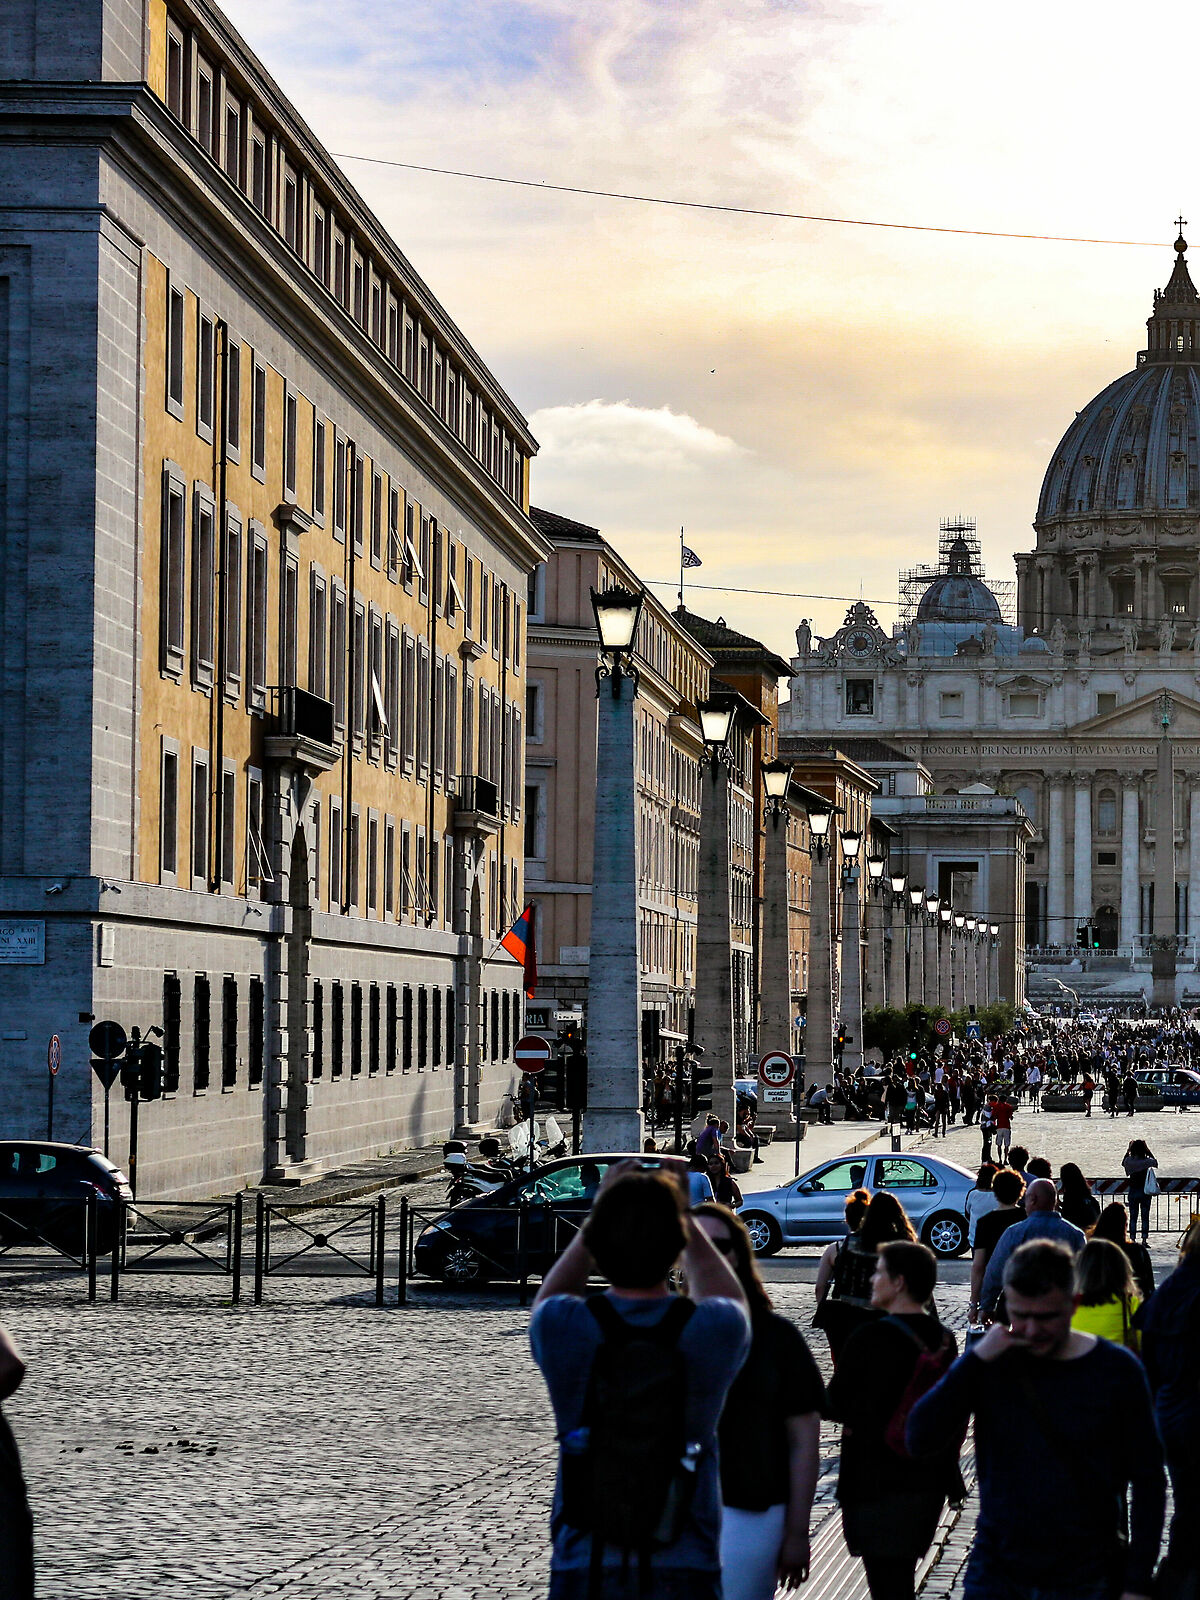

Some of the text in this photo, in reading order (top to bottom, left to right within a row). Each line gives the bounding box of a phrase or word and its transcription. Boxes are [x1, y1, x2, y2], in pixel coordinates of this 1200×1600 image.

[904, 745, 916, 754] IN
[922, 745, 979, 755] HONOREM
[982, 745, 1038, 755] PRINCIPIS
[1076, 746, 1113, 755] PAVLVS
[17, 937, 36, 945] XXIII
